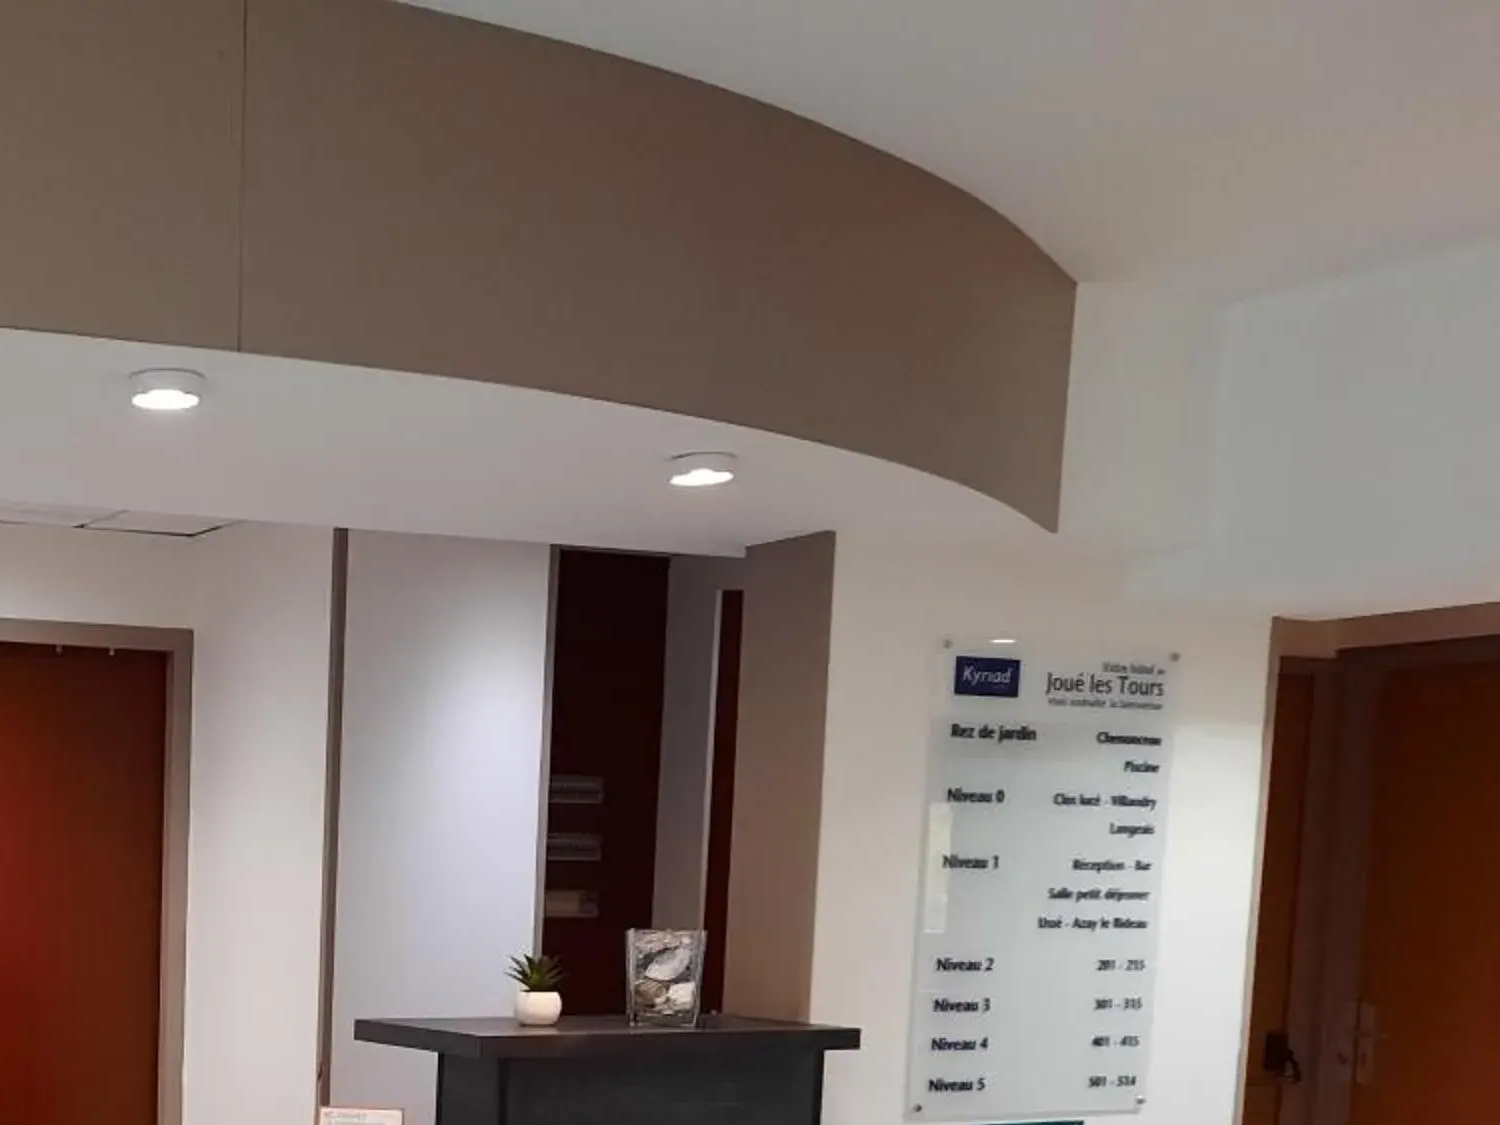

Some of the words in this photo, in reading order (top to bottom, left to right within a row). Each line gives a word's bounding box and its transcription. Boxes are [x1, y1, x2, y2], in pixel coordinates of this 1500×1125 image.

[1045, 671, 1084, 695] Joué
[1088, 673, 1112, 694] les
[1116, 675, 1164, 697] Tours
[950, 723, 975, 739] Rez
[978, 724, 996, 739] de
[998, 725, 1037, 744] jardin
[947, 787, 993, 804] Niveau
[996, 788, 1005, 804] 0
[942, 854, 989, 869] Niveau
[993, 855, 999, 869] 1
[1076, 888, 1101, 903] petit
[936, 957, 982, 972] Niveau
[984, 957, 995, 972] 2
[932, 997, 979, 1013] Niveau
[982, 997, 991, 1013] 3
[931, 1037, 976, 1051] Niveau
[979, 1036, 989, 1049] 4
[927, 1077, 973, 1092] Niveau
[976, 1077, 987, 1092] 5
